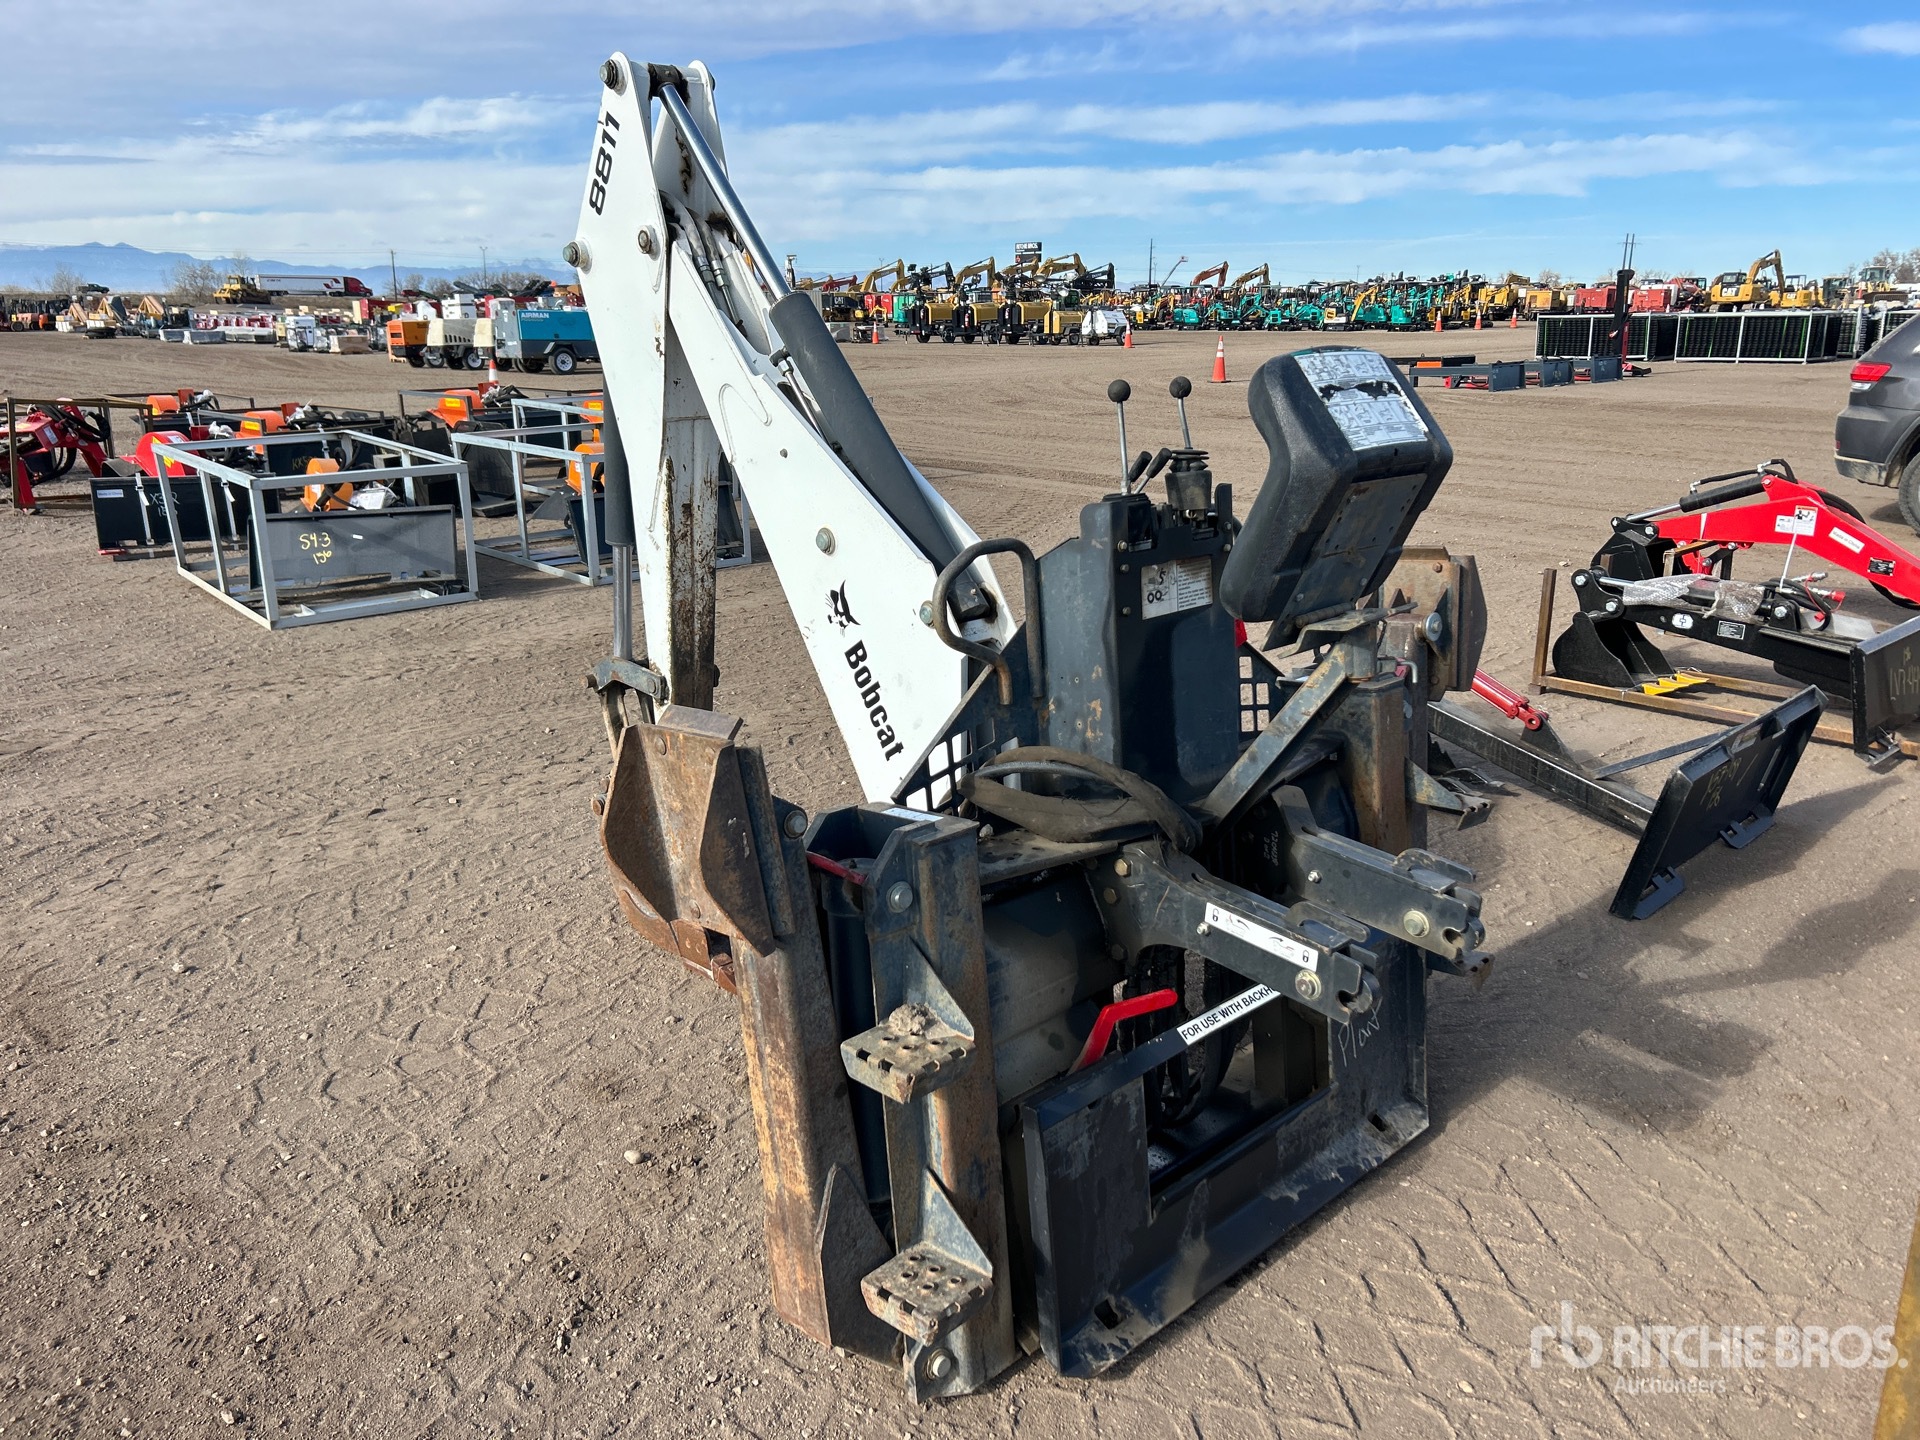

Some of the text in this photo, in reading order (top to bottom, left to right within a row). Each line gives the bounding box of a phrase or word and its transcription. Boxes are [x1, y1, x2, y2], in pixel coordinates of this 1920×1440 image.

[589, 111, 620, 216] 8811
[834, 296, 844, 304] CAT
[1722, 288, 1737, 297] CAT
[1832, 530, 1844, 540] Made
[1848, 540, 1861, 550] China
[844, 639, 904, 762] Bobcat
[1181, 986, 1276, 1040] FOR USE WITH BACKH
